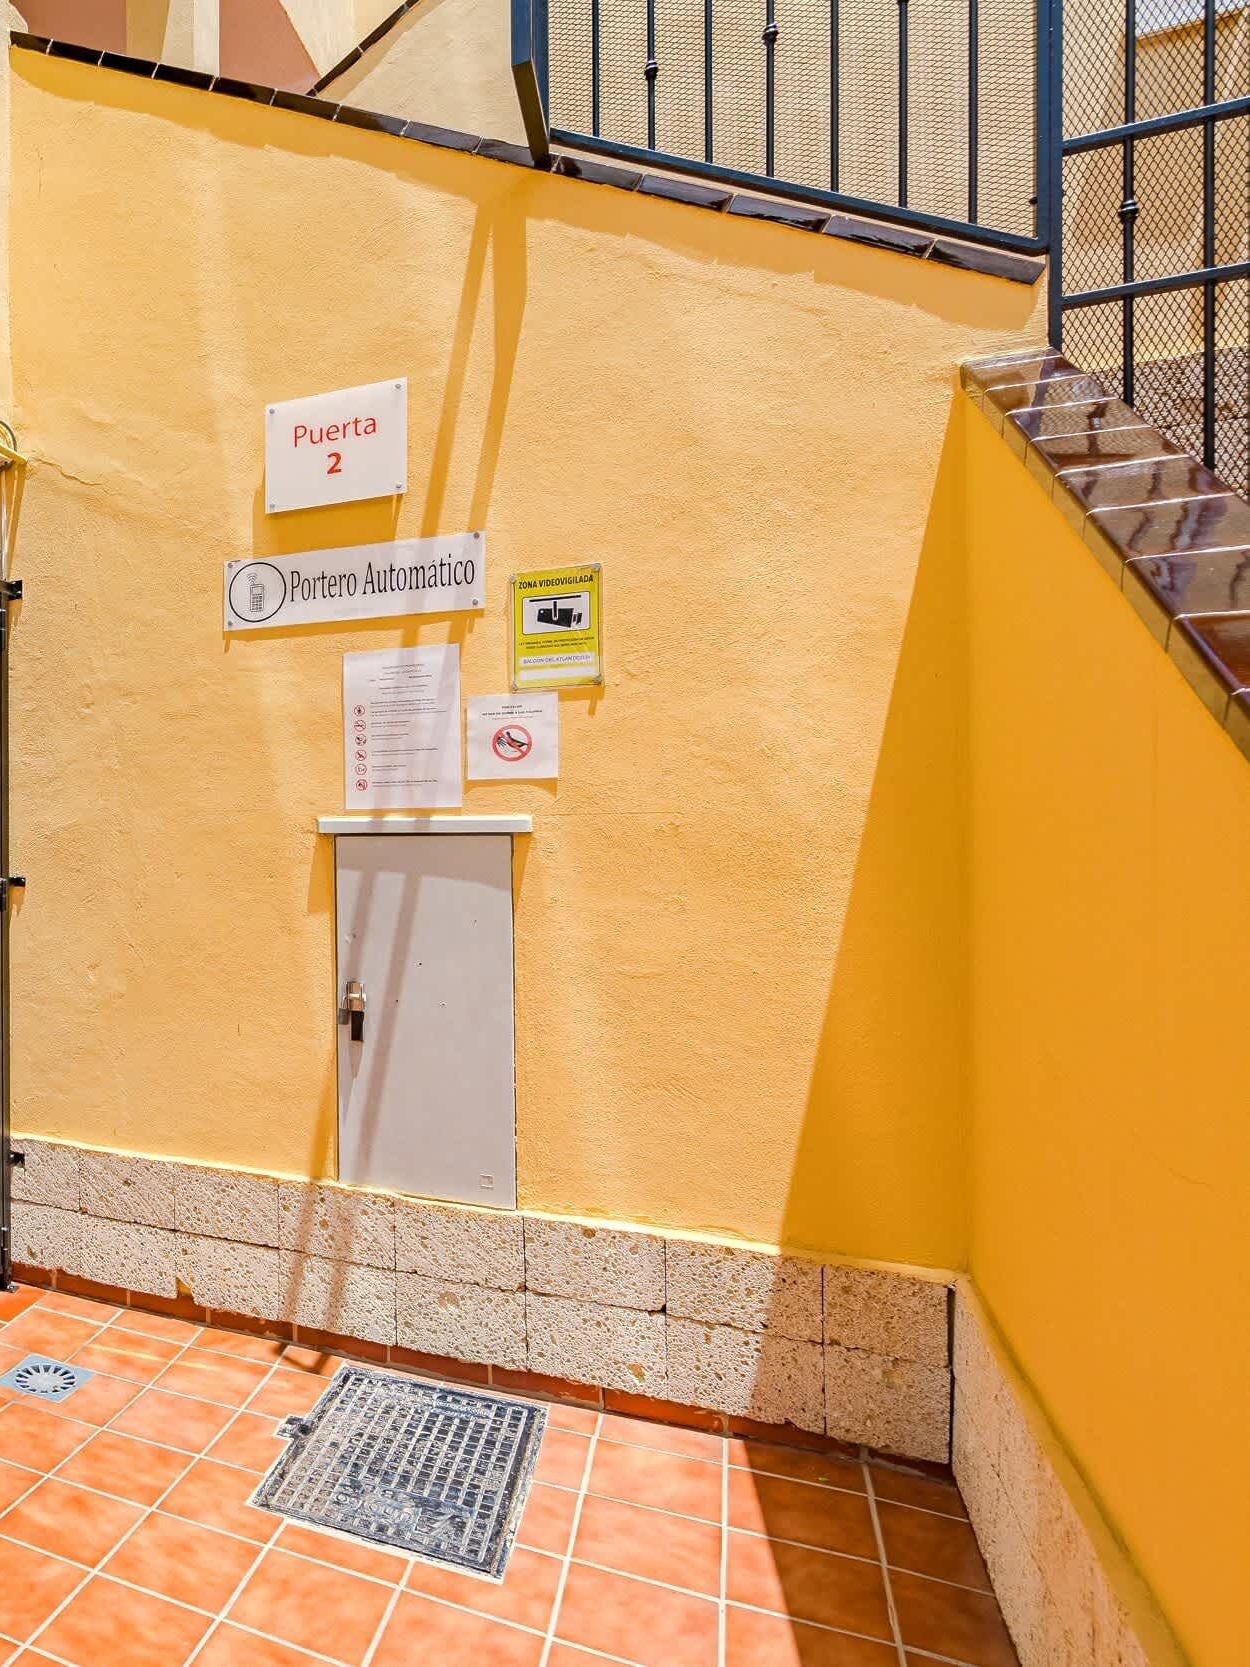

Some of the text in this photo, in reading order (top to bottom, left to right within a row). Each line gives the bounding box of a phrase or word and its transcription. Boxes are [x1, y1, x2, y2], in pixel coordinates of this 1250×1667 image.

[294, 417, 376, 448] Puerta
[326, 452, 342, 475] 2
[290, 553, 475, 602] Portero Automático
[518, 574, 594, 590] ZONA VIDEOVIGILADA
